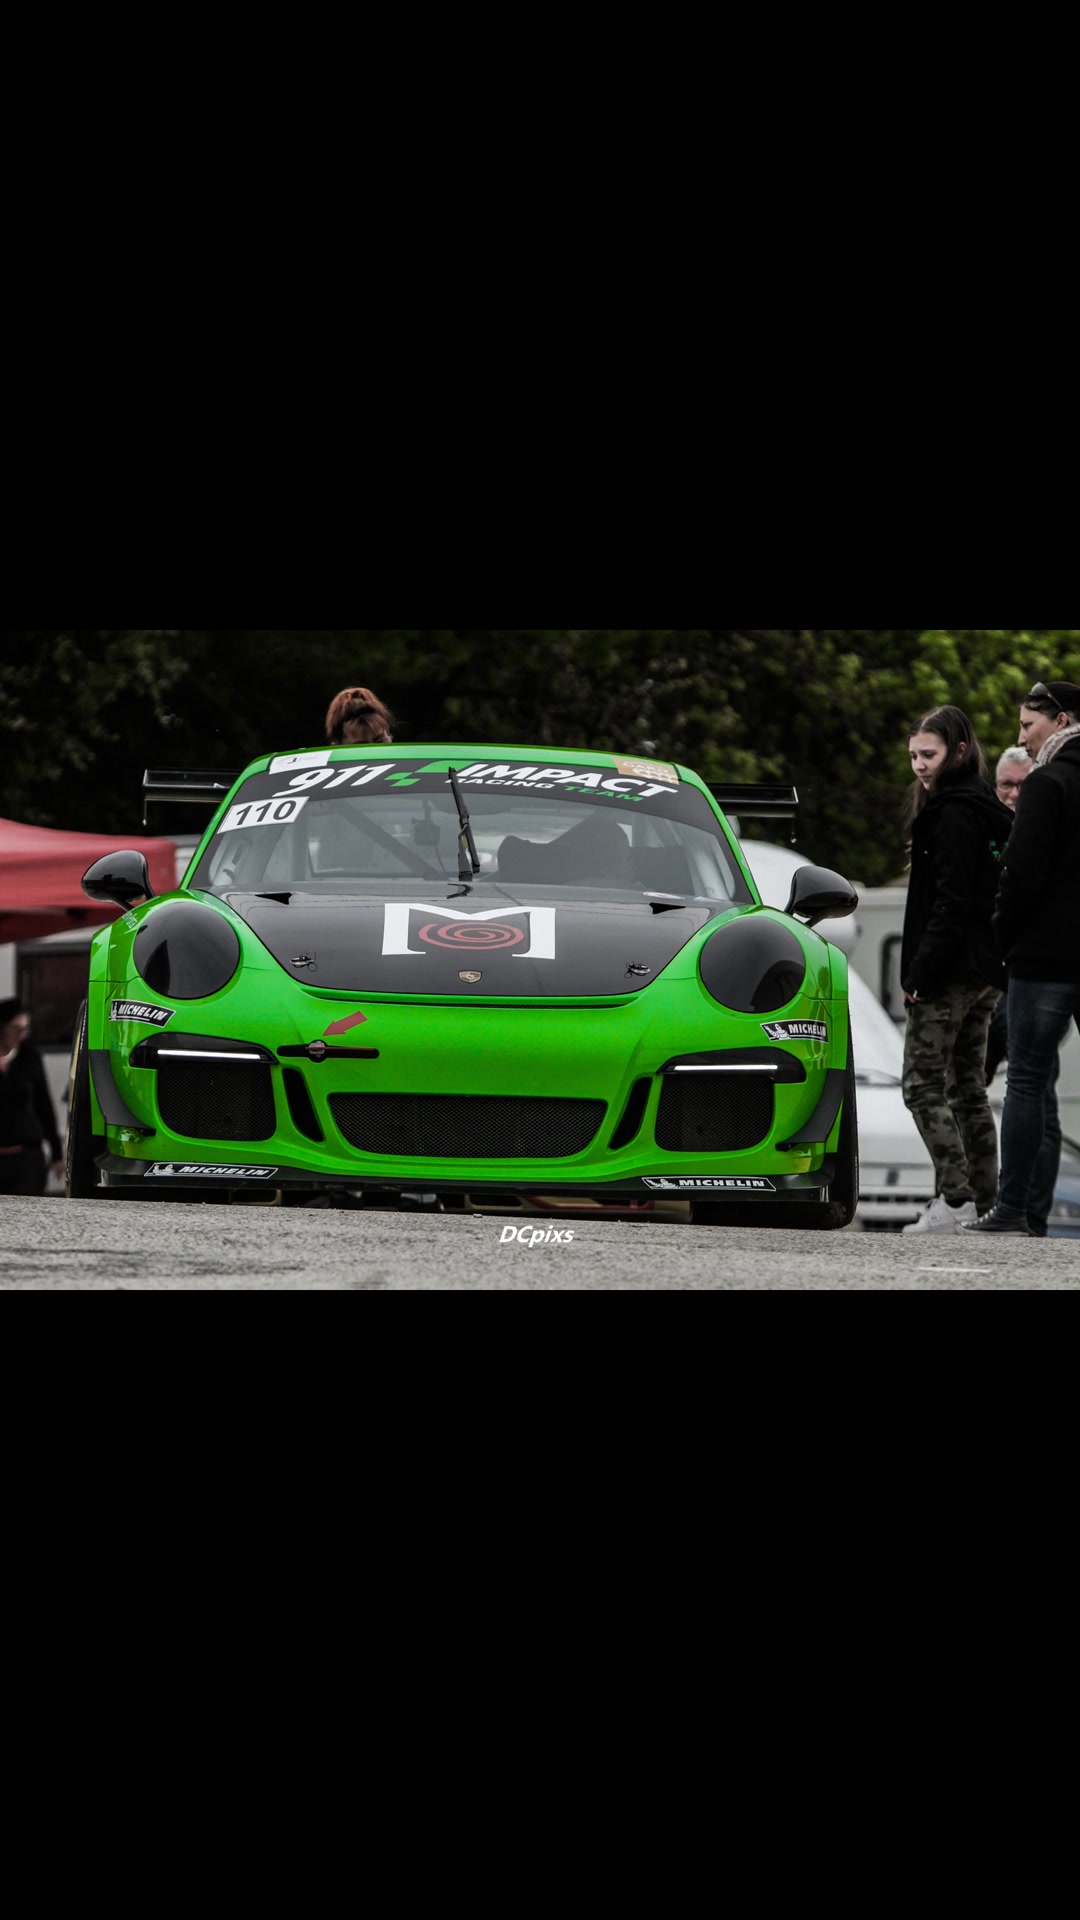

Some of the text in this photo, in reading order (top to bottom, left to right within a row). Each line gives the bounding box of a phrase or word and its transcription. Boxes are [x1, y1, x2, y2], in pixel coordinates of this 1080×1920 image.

[272, 763, 679, 797] 911 IMPACT
[564, 785, 645, 802] TEAM
[235, 800, 297, 827] 110
[118, 1003, 168, 1021] MICHELIN
[788, 1023, 827, 1037] MICHELIN
[178, 1165, 270, 1176] MICHELIN
[679, 1179, 765, 1187] MICHELIN
